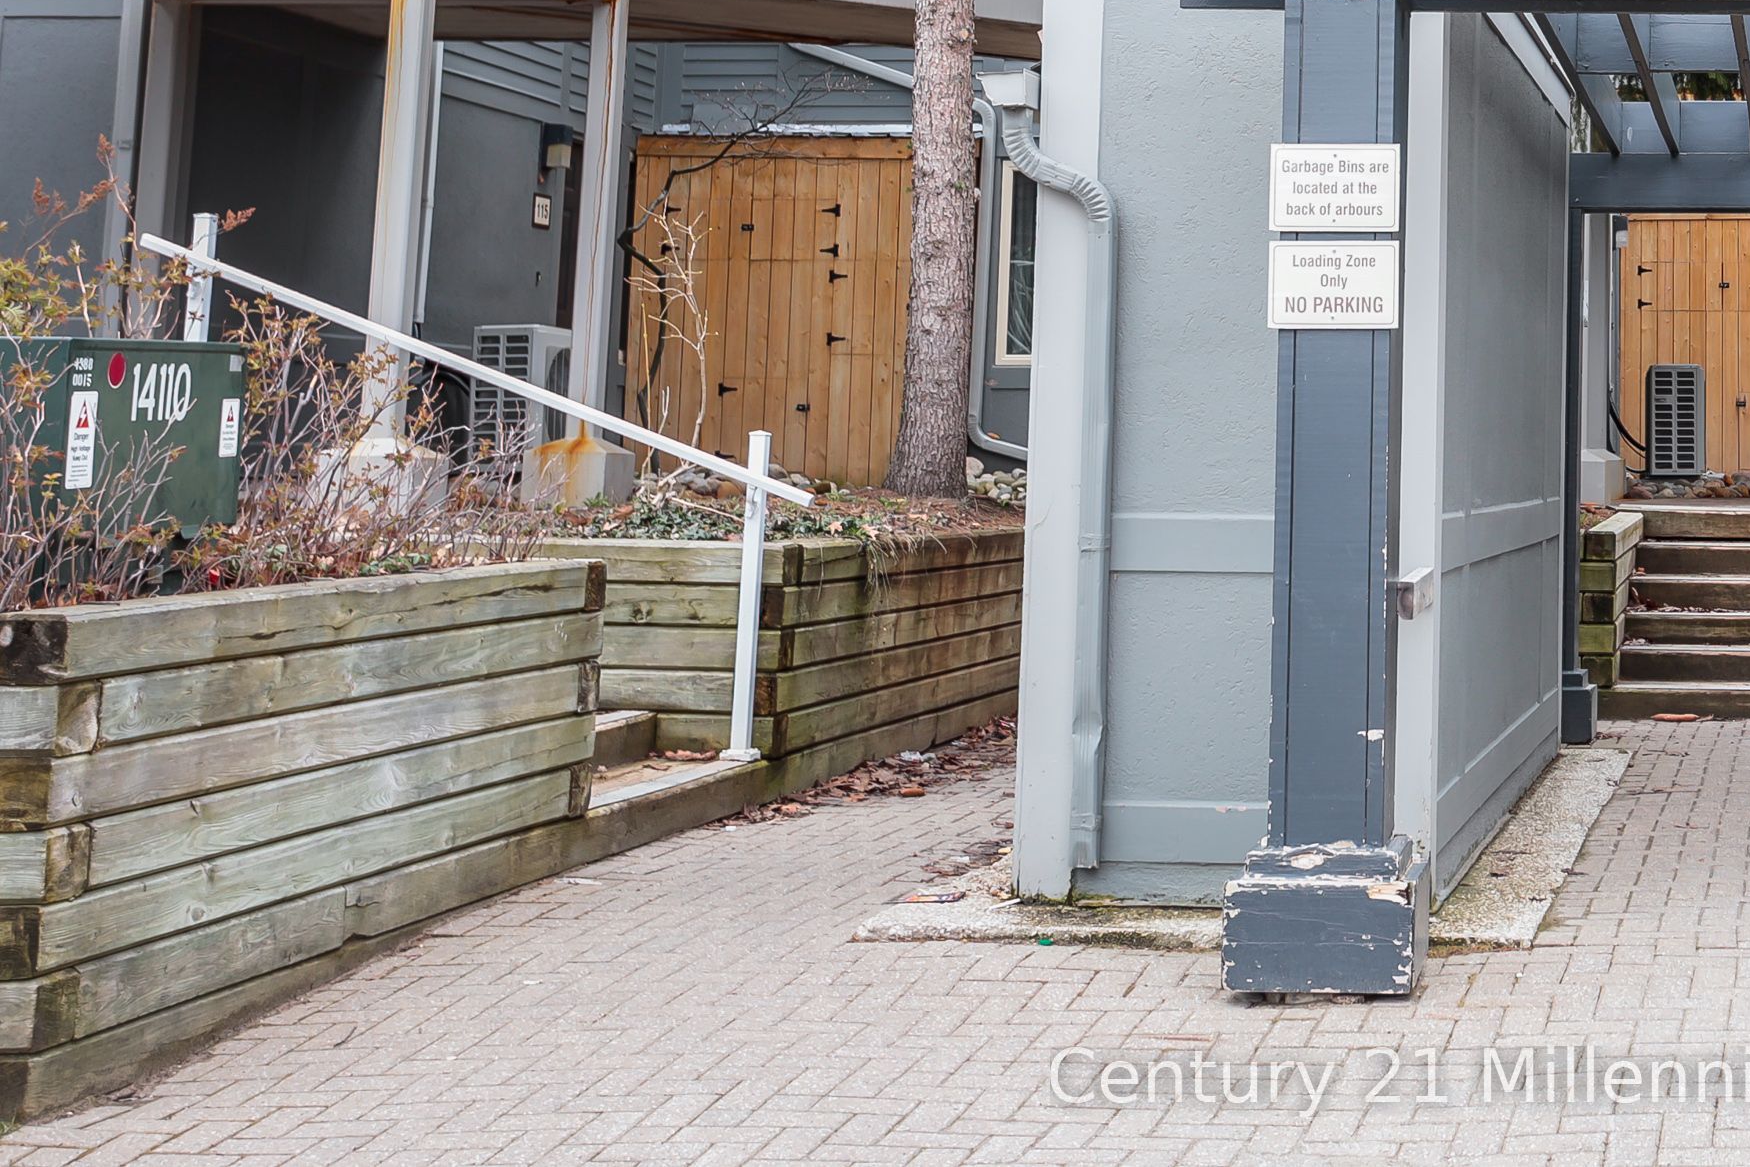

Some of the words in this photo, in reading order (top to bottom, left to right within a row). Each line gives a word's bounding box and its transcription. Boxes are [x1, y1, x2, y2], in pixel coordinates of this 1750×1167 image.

[1282, 160, 1334, 176] Garbage
[1339, 160, 1365, 173] Bins
[1369, 162, 1389, 173] are
[1293, 181, 1338, 194] located
[1342, 181, 1354, 194] at
[1358, 181, 1377, 194] the
[537, 204, 548, 219] 115
[1286, 202, 1316, 216] back
[1320, 202, 1332, 216] of
[1335, 202, 1383, 216] arbours
[1293, 254, 1342, 270] Loading
[1346, 254, 1376, 267] Zone
[1320, 273, 1348, 290] Only
[1285, 297, 1307, 313] NO
[1313, 297, 1384, 313] PARKING
[72, 373, 93, 387] 0015
[131, 363, 192, 422] 14110
